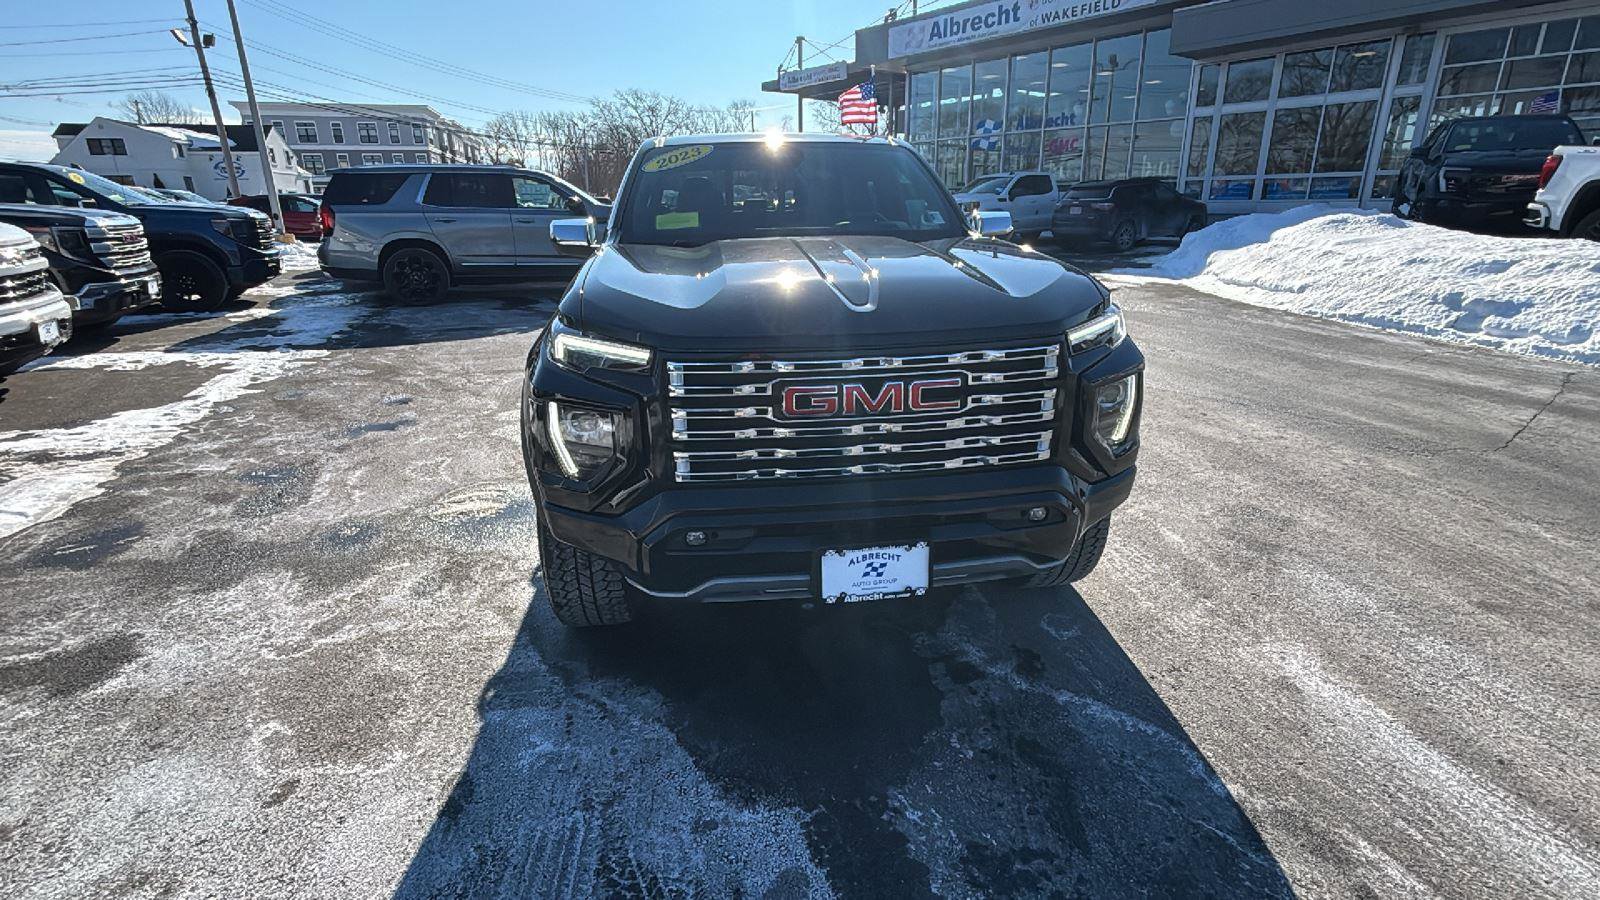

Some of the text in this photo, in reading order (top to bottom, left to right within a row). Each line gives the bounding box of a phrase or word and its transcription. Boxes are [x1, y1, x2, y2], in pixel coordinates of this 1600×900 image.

[928, 0, 1021, 42] Albrecht
[1041, 0, 1121, 24] WAKEFIELD
[656, 147, 702, 169] 2023
[782, 378, 962, 417] GMC
[848, 552, 902, 567] ALBRECHT
[852, 577, 898, 588] AUTO GROUP
[844, 592, 883, 603] Albrecht
